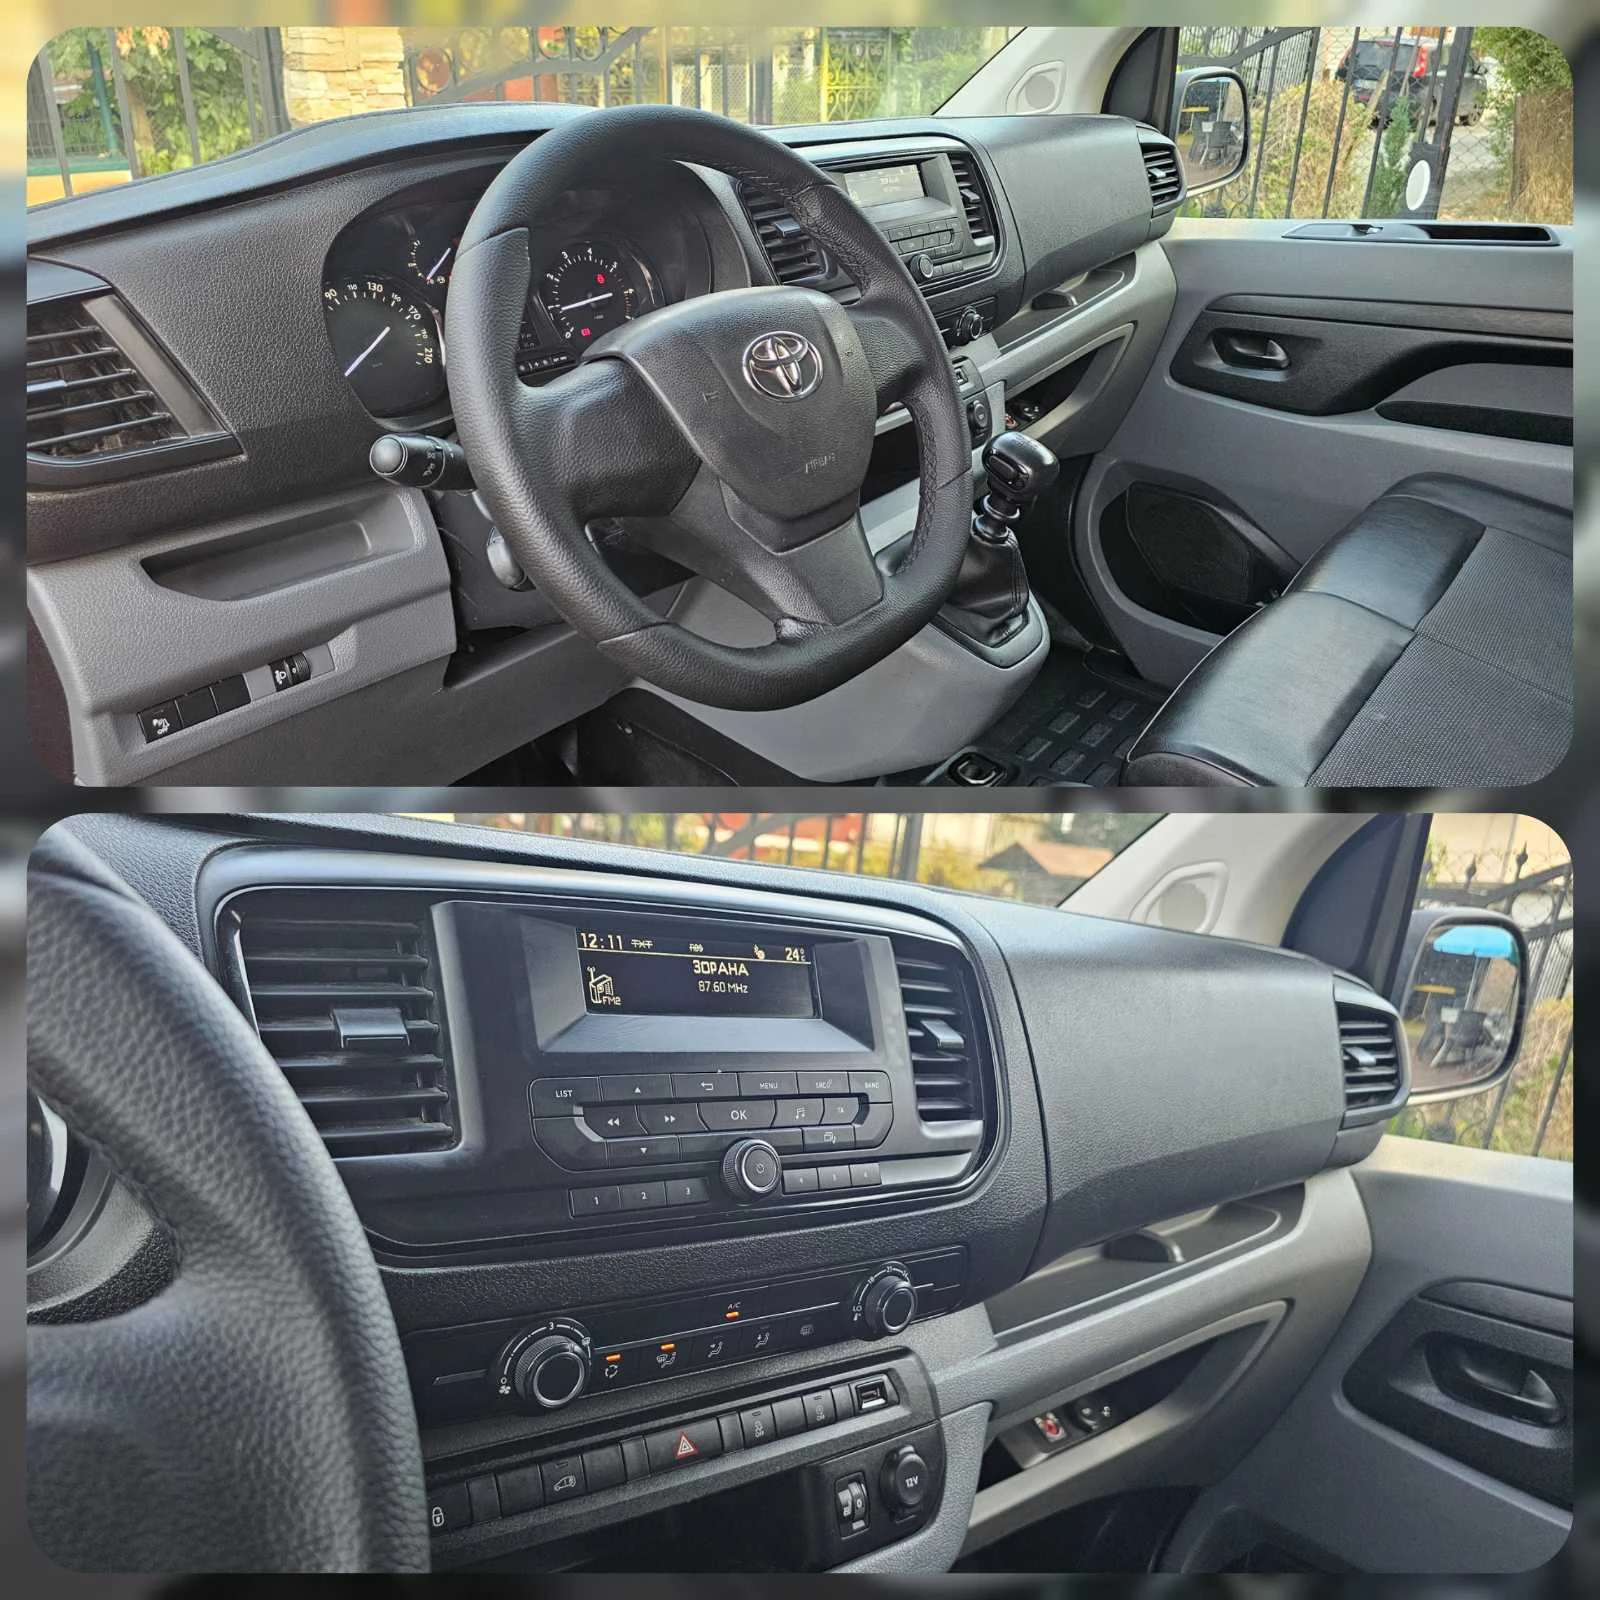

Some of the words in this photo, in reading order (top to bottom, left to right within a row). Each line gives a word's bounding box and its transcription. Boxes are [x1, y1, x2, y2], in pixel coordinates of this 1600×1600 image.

[561, 251, 568, 259] 3
[367, 281, 383, 293] 130
[324, 288, 337, 300] 90
[408, 305, 421, 320] 170
[565, 331, 571, 339] 0
[424, 347, 433, 364] 210
[580, 932, 623, 950] 12:11
[692, 959, 750, 977] ЗОРАНА
[698, 980, 726, 993] 87.60
[727, 983, 749, 994] MHz
[602, 996, 622, 1006] FM2
[759, 1082, 778, 1090] MENU
[555, 1088, 574, 1099] LIST
[730, 1109, 748, 1121] OK
[594, 1196, 599, 1205] 1
[641, 1191, 648, 1200] 2
[727, 1302, 741, 1310] A/C
[548, 1321, 555, 1331] 3
[905, 1475, 919, 1488] 12V
